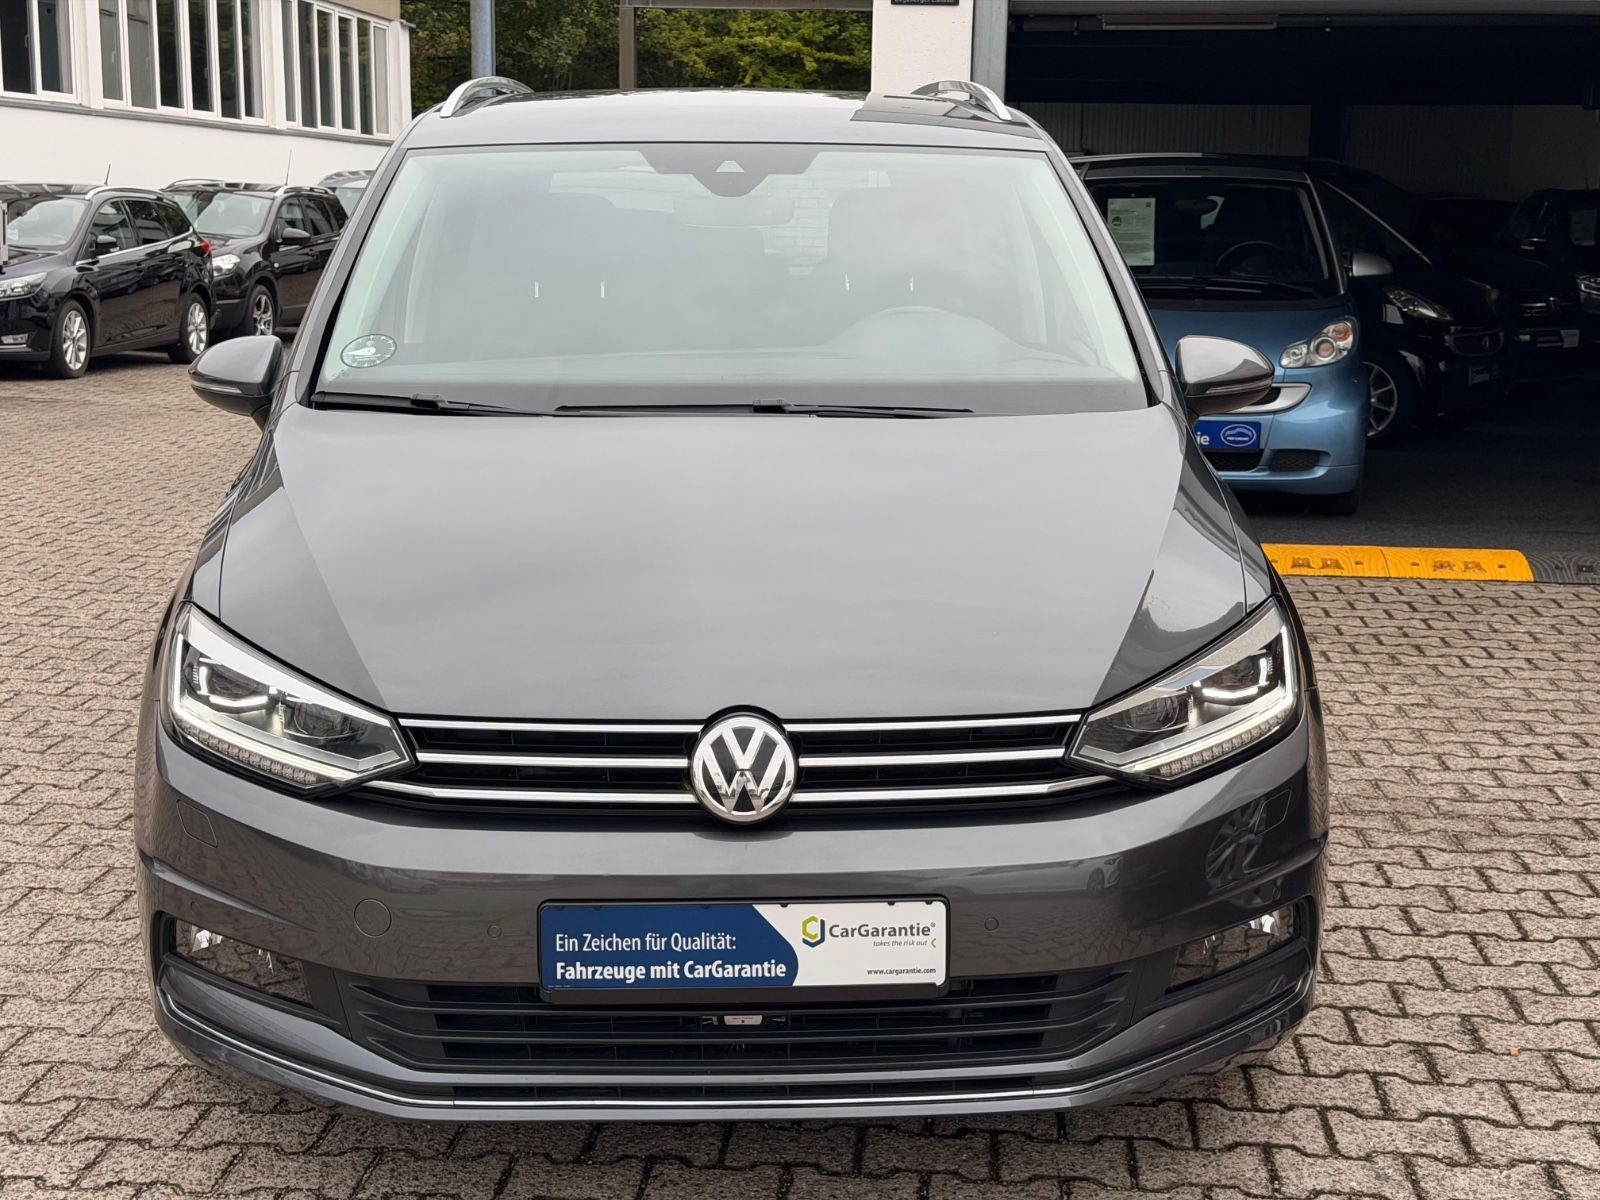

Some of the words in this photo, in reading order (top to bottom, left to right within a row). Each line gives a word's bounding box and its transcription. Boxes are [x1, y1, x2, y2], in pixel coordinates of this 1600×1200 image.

[556, 933, 579, 952] Ein
[582, 932, 641, 952] Zeichen
[645, 932, 668, 951] für
[671, 931, 737, 952] Qualität:
[891, 939, 903, 947] the
[556, 961, 646, 984] Fahrzeuge
[650, 960, 681, 979] mit
[683, 959, 787, 979] CarGarantie
[867, 967, 937, 976] www.cargarantie.com
